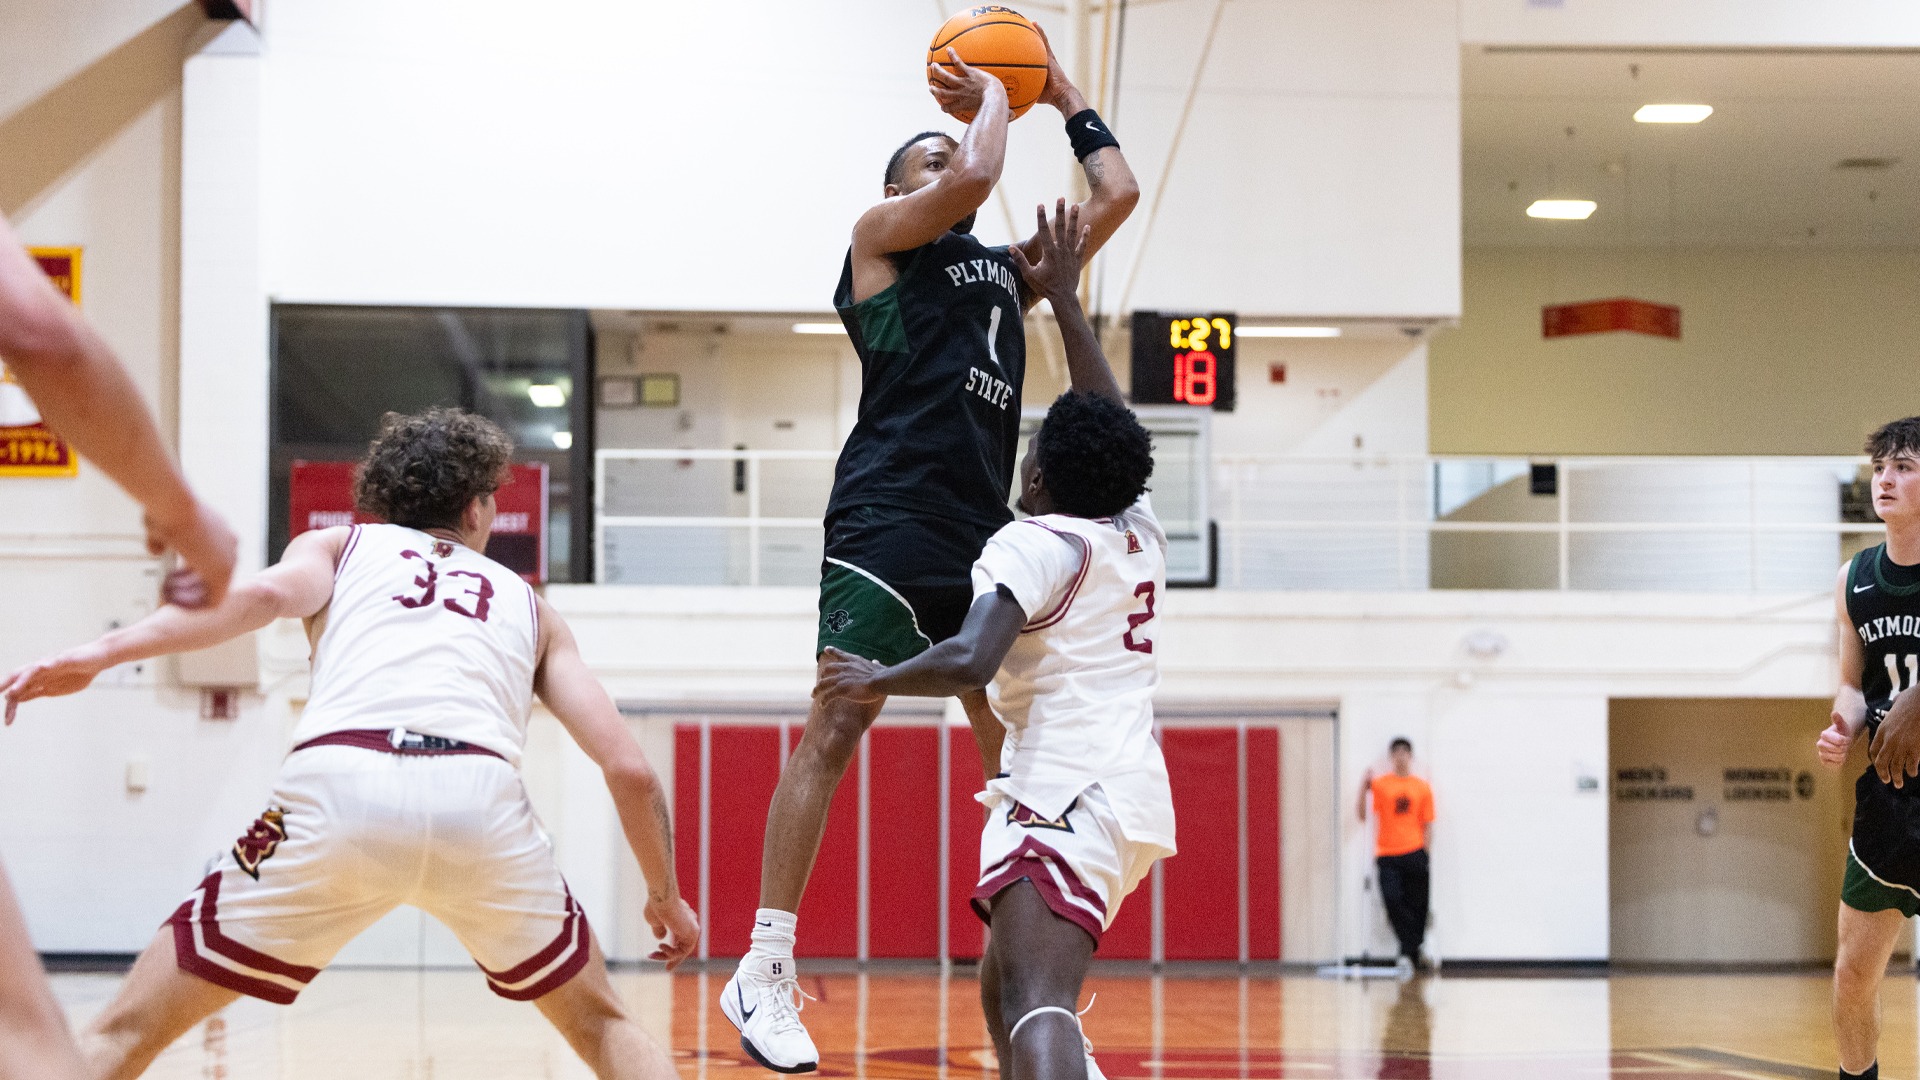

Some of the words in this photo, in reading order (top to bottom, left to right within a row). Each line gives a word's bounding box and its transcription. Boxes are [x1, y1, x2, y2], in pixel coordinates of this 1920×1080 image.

[987, 305, 1002, 365] 1
[1170, 317, 1231, 351] 1:27
[965, 366, 1013, 411] STATE
[1173, 350, 1217, 406] 18
[392, 550, 494, 623] 33
[1123, 580, 1156, 654] 2
[1884, 654, 1919, 700] 11
